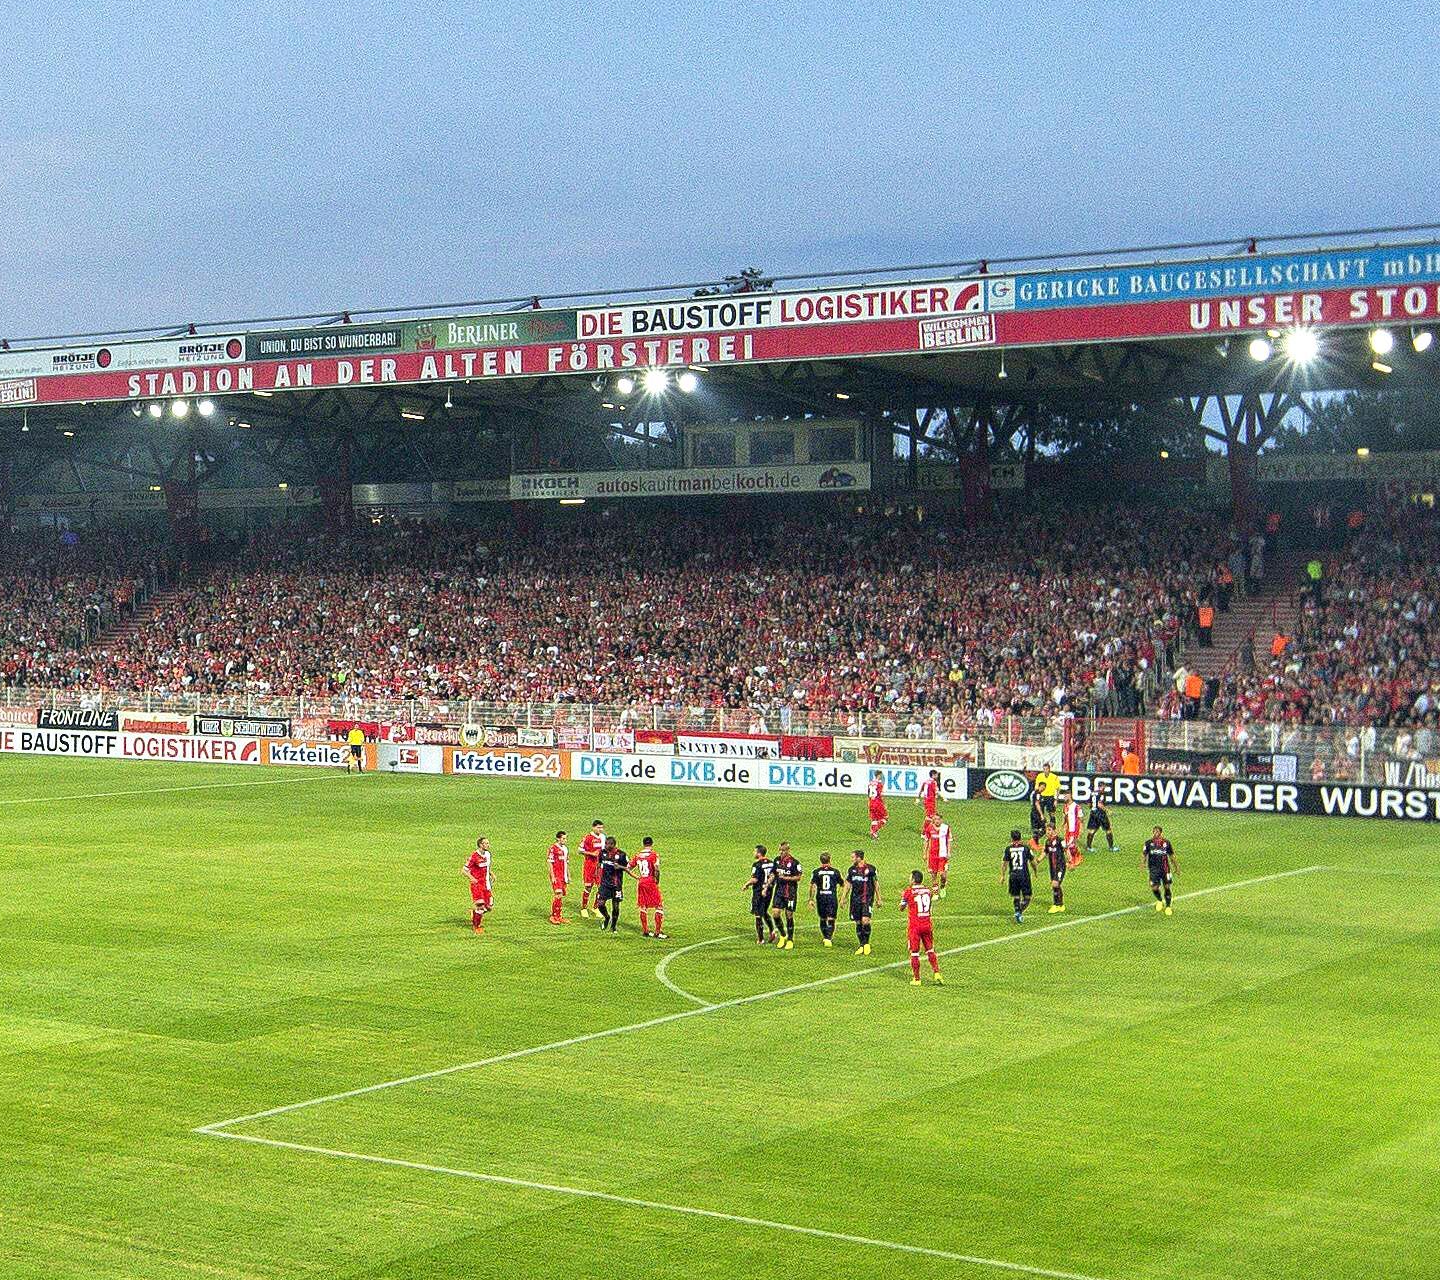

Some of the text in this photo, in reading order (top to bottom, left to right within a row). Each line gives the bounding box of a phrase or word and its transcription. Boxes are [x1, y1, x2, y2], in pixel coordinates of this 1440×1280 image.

[1019, 277, 1118, 301] GERICKE
[1129, 259, 1369, 295] BAUGESELLSCHAFT
[581, 286, 948, 337] DIE BAUSTOFF LOGISTIKER
[1190, 293, 1323, 329] UNSER
[448, 321, 518, 345] BERLINER
[923, 315, 989, 332] WILLKOMMEN
[290, 339, 303, 353] DU
[304, 338, 323, 351] BIST
[324, 337, 336, 350] SO
[923, 325, 990, 348] BERLIN!
[129, 334, 752, 397] STADION AN DER ALTEN FÖRSTEREI
[532, 478, 579, 488] KOCH
[597, 471, 800, 494] autoskauftmanbeikoch.de
[40, 710, 113, 727] FRONTLINE
[21, 732, 118, 755] BAUSTOFF
[123, 736, 236, 760] LOGISTIKER
[455, 754, 558, 775] kfzteile24
[580, 756, 656, 779] DKB.de
[670, 760, 750, 784] DKB.de
[769, 765, 852, 788] DKB.de
[822, 875, 830, 890] 8
[916, 893, 930, 912] 19
